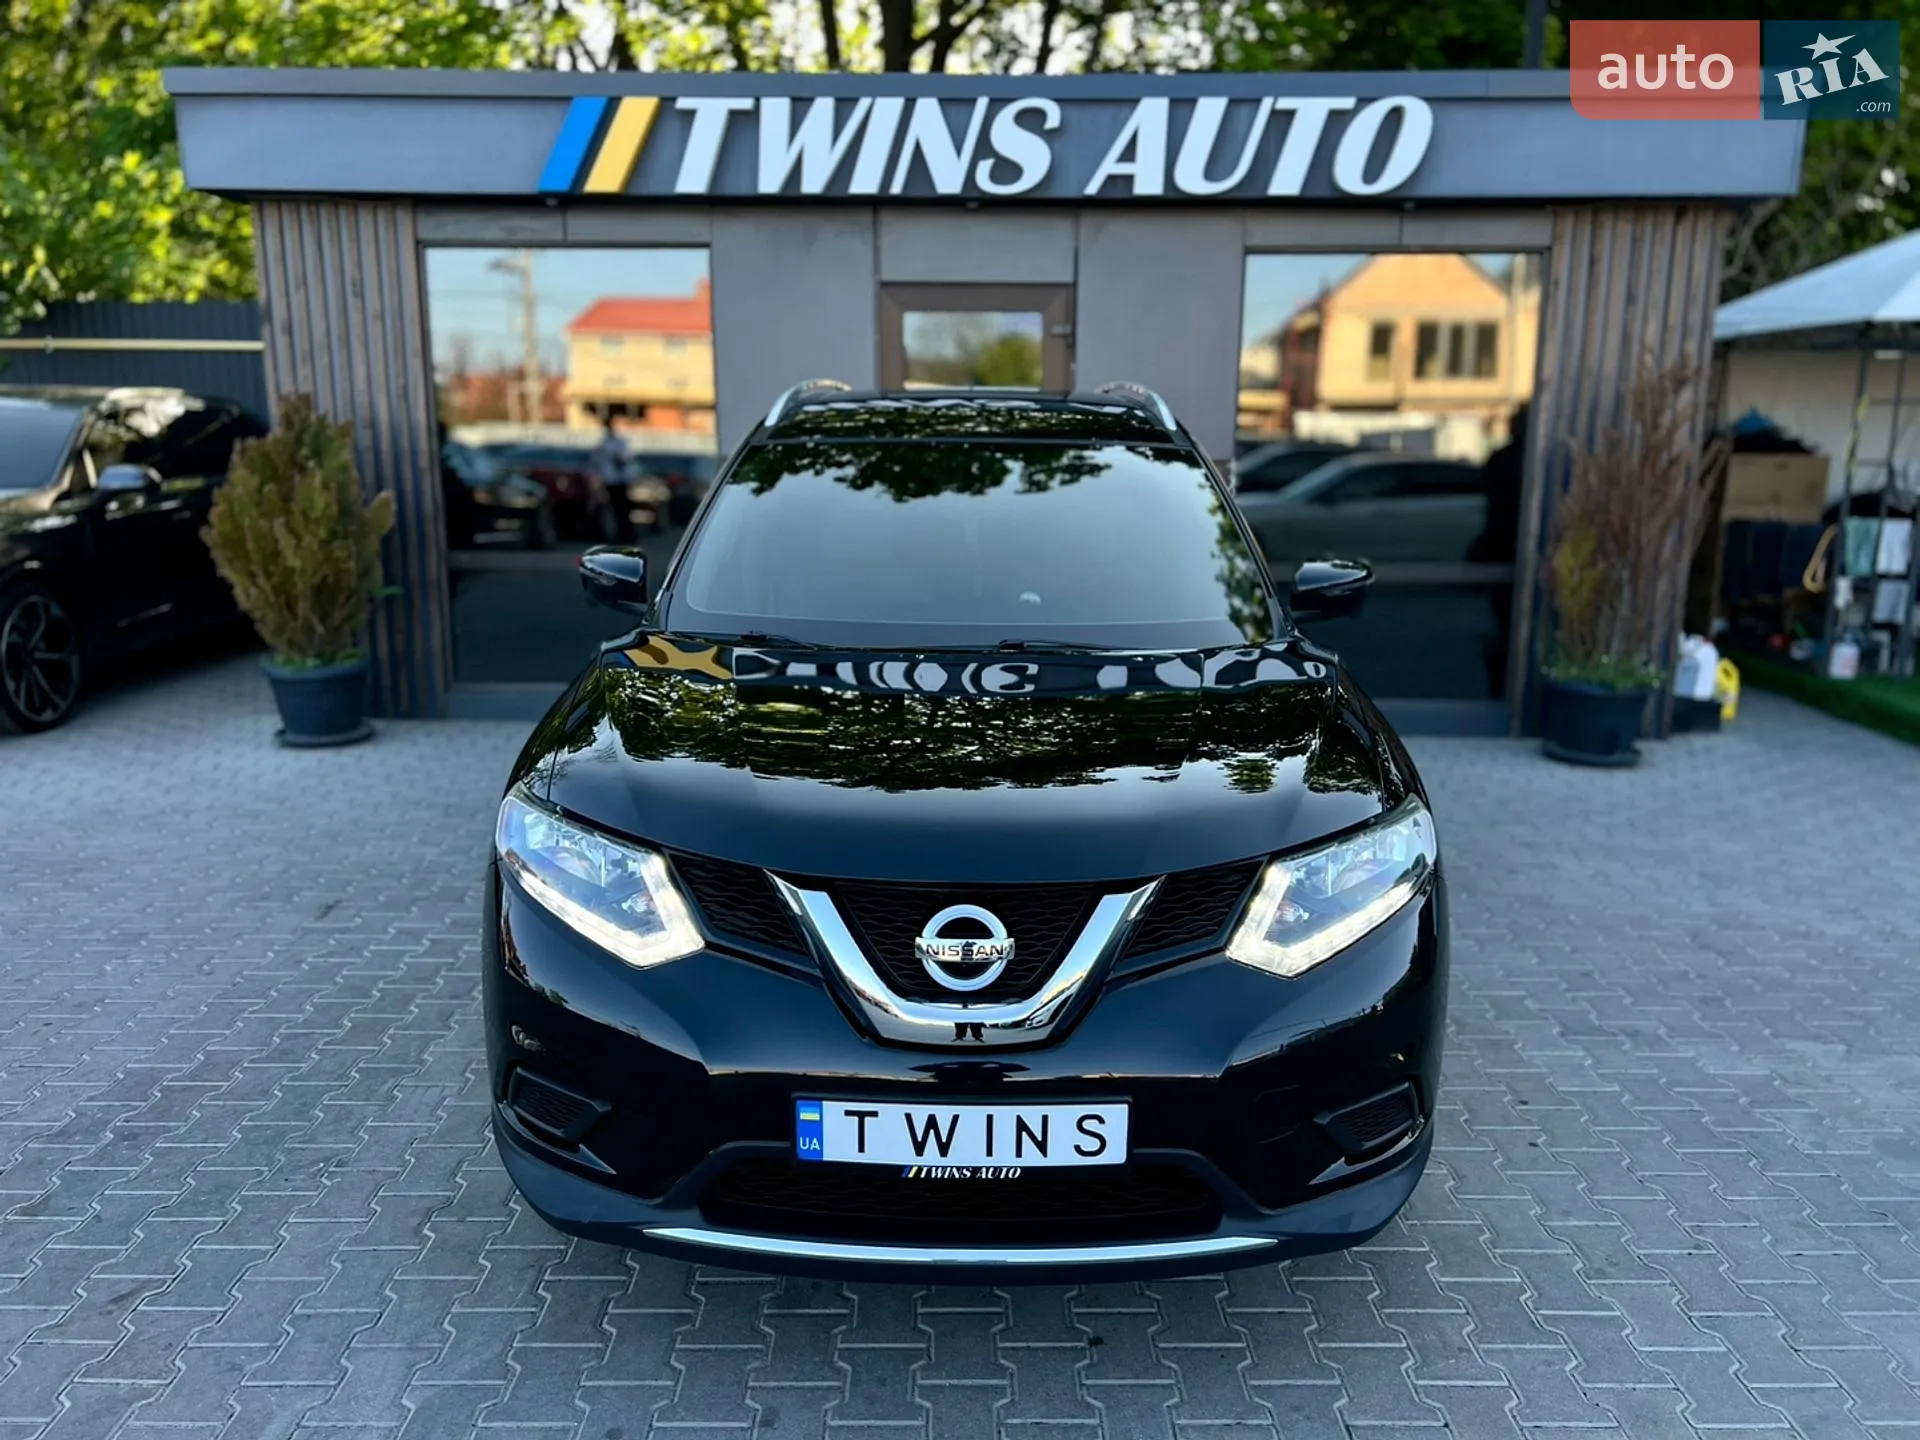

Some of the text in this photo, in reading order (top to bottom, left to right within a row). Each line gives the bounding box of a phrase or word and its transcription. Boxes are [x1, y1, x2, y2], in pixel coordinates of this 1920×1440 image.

[673, 95, 1434, 196] TWINS AUTO
[926, 944, 1004, 956] NISSAN
[800, 1137, 820, 1151] UA
[919, 1166, 1021, 1179] TWINS AUTO
